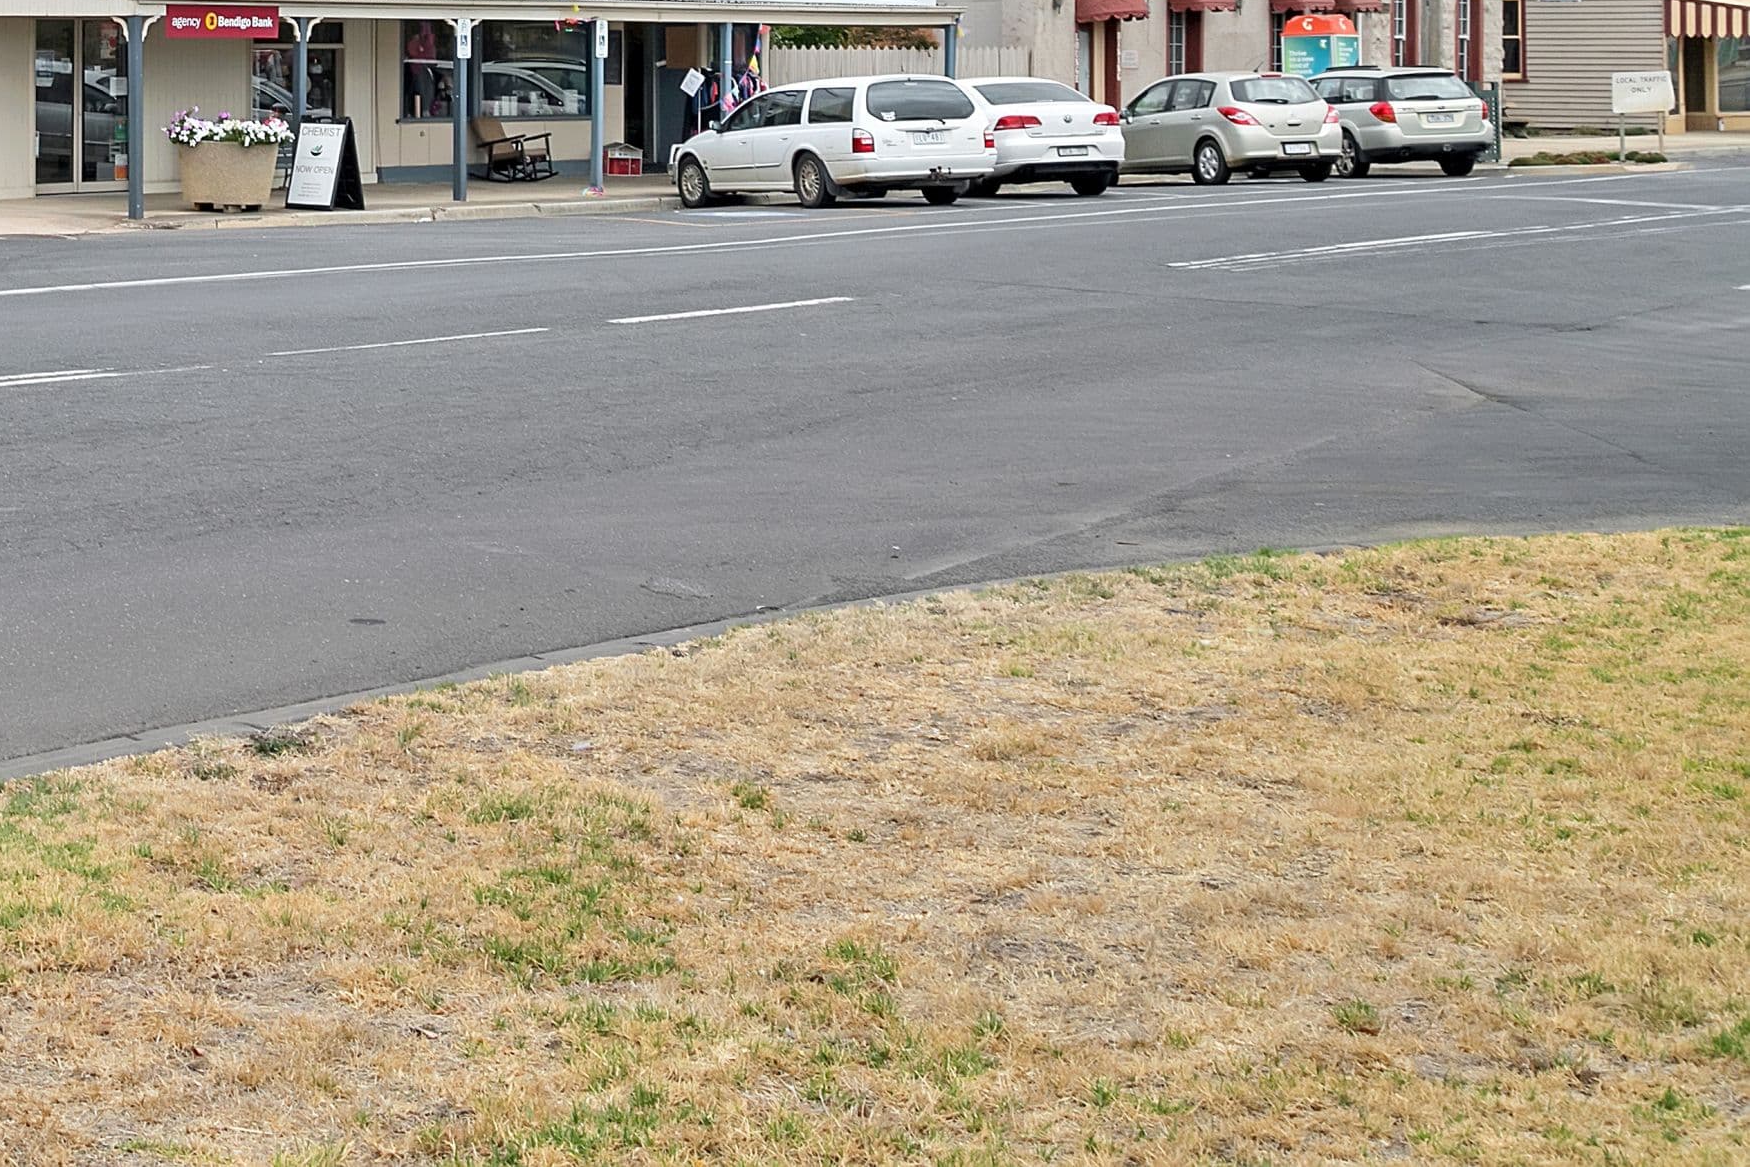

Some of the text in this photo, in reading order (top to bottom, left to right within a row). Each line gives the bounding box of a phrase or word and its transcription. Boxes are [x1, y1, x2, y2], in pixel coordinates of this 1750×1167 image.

[171, 15, 274, 30] agency Bendigo Bank
[1616, 75, 1667, 84] LOCAL TRAFFIC
[302, 126, 342, 137] CHEMIST
[296, 165, 335, 175] NOW OPEN
